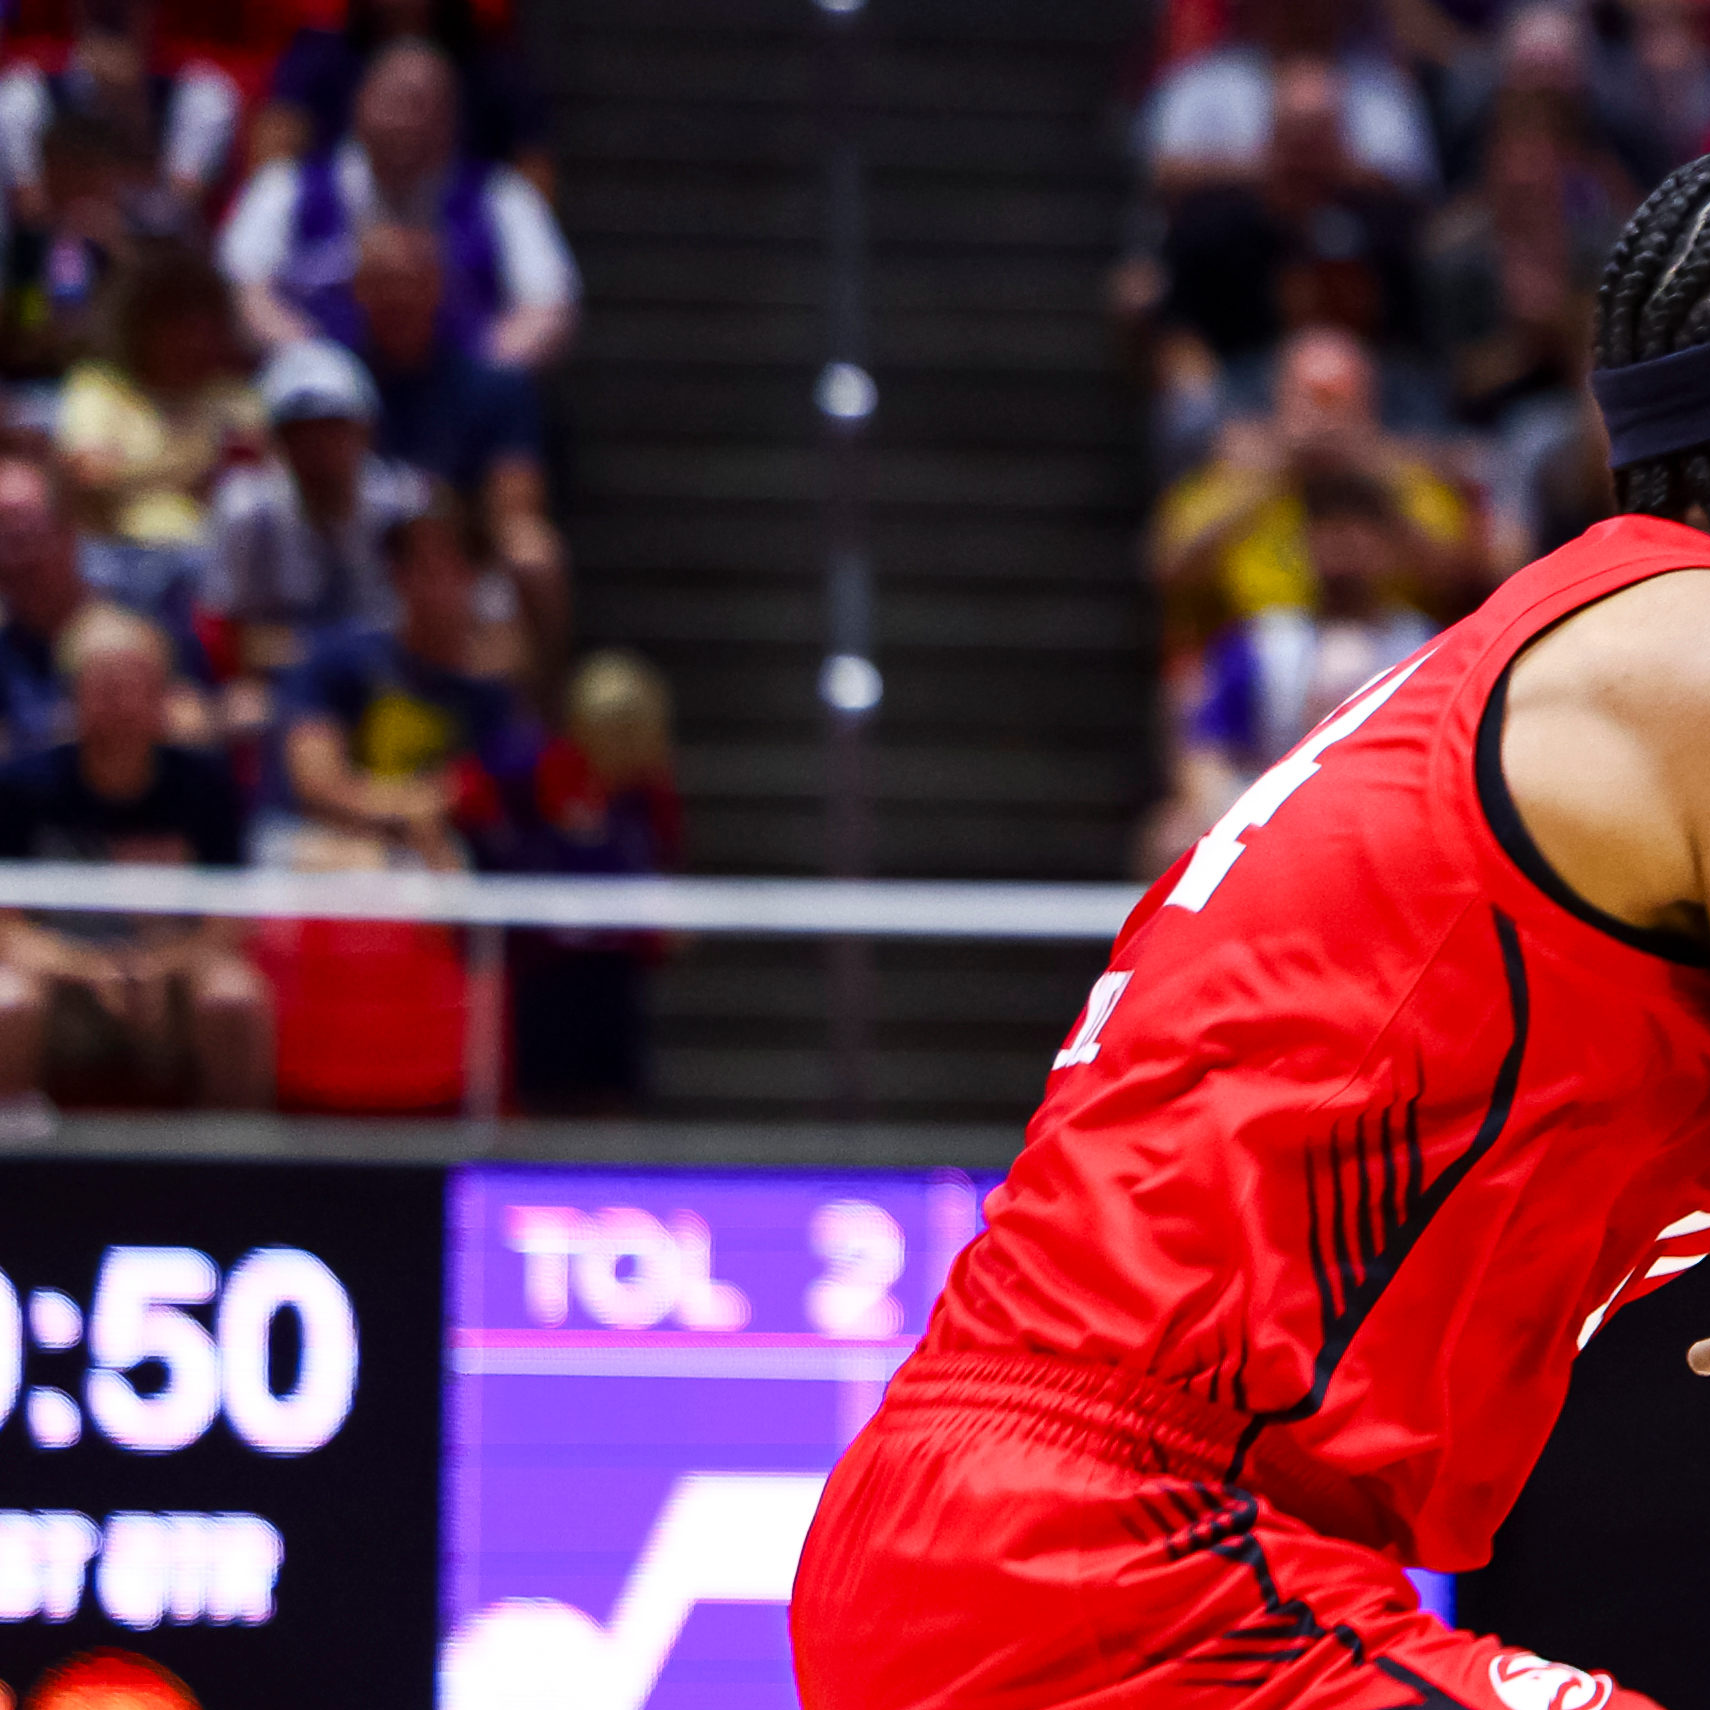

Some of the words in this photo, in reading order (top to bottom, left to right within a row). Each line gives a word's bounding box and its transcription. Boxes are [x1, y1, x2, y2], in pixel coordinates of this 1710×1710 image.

[0, 1244, 360, 1456] :50
[502, 1204, 751, 1334] TOL
[806, 1199, 906, 1339] 2
